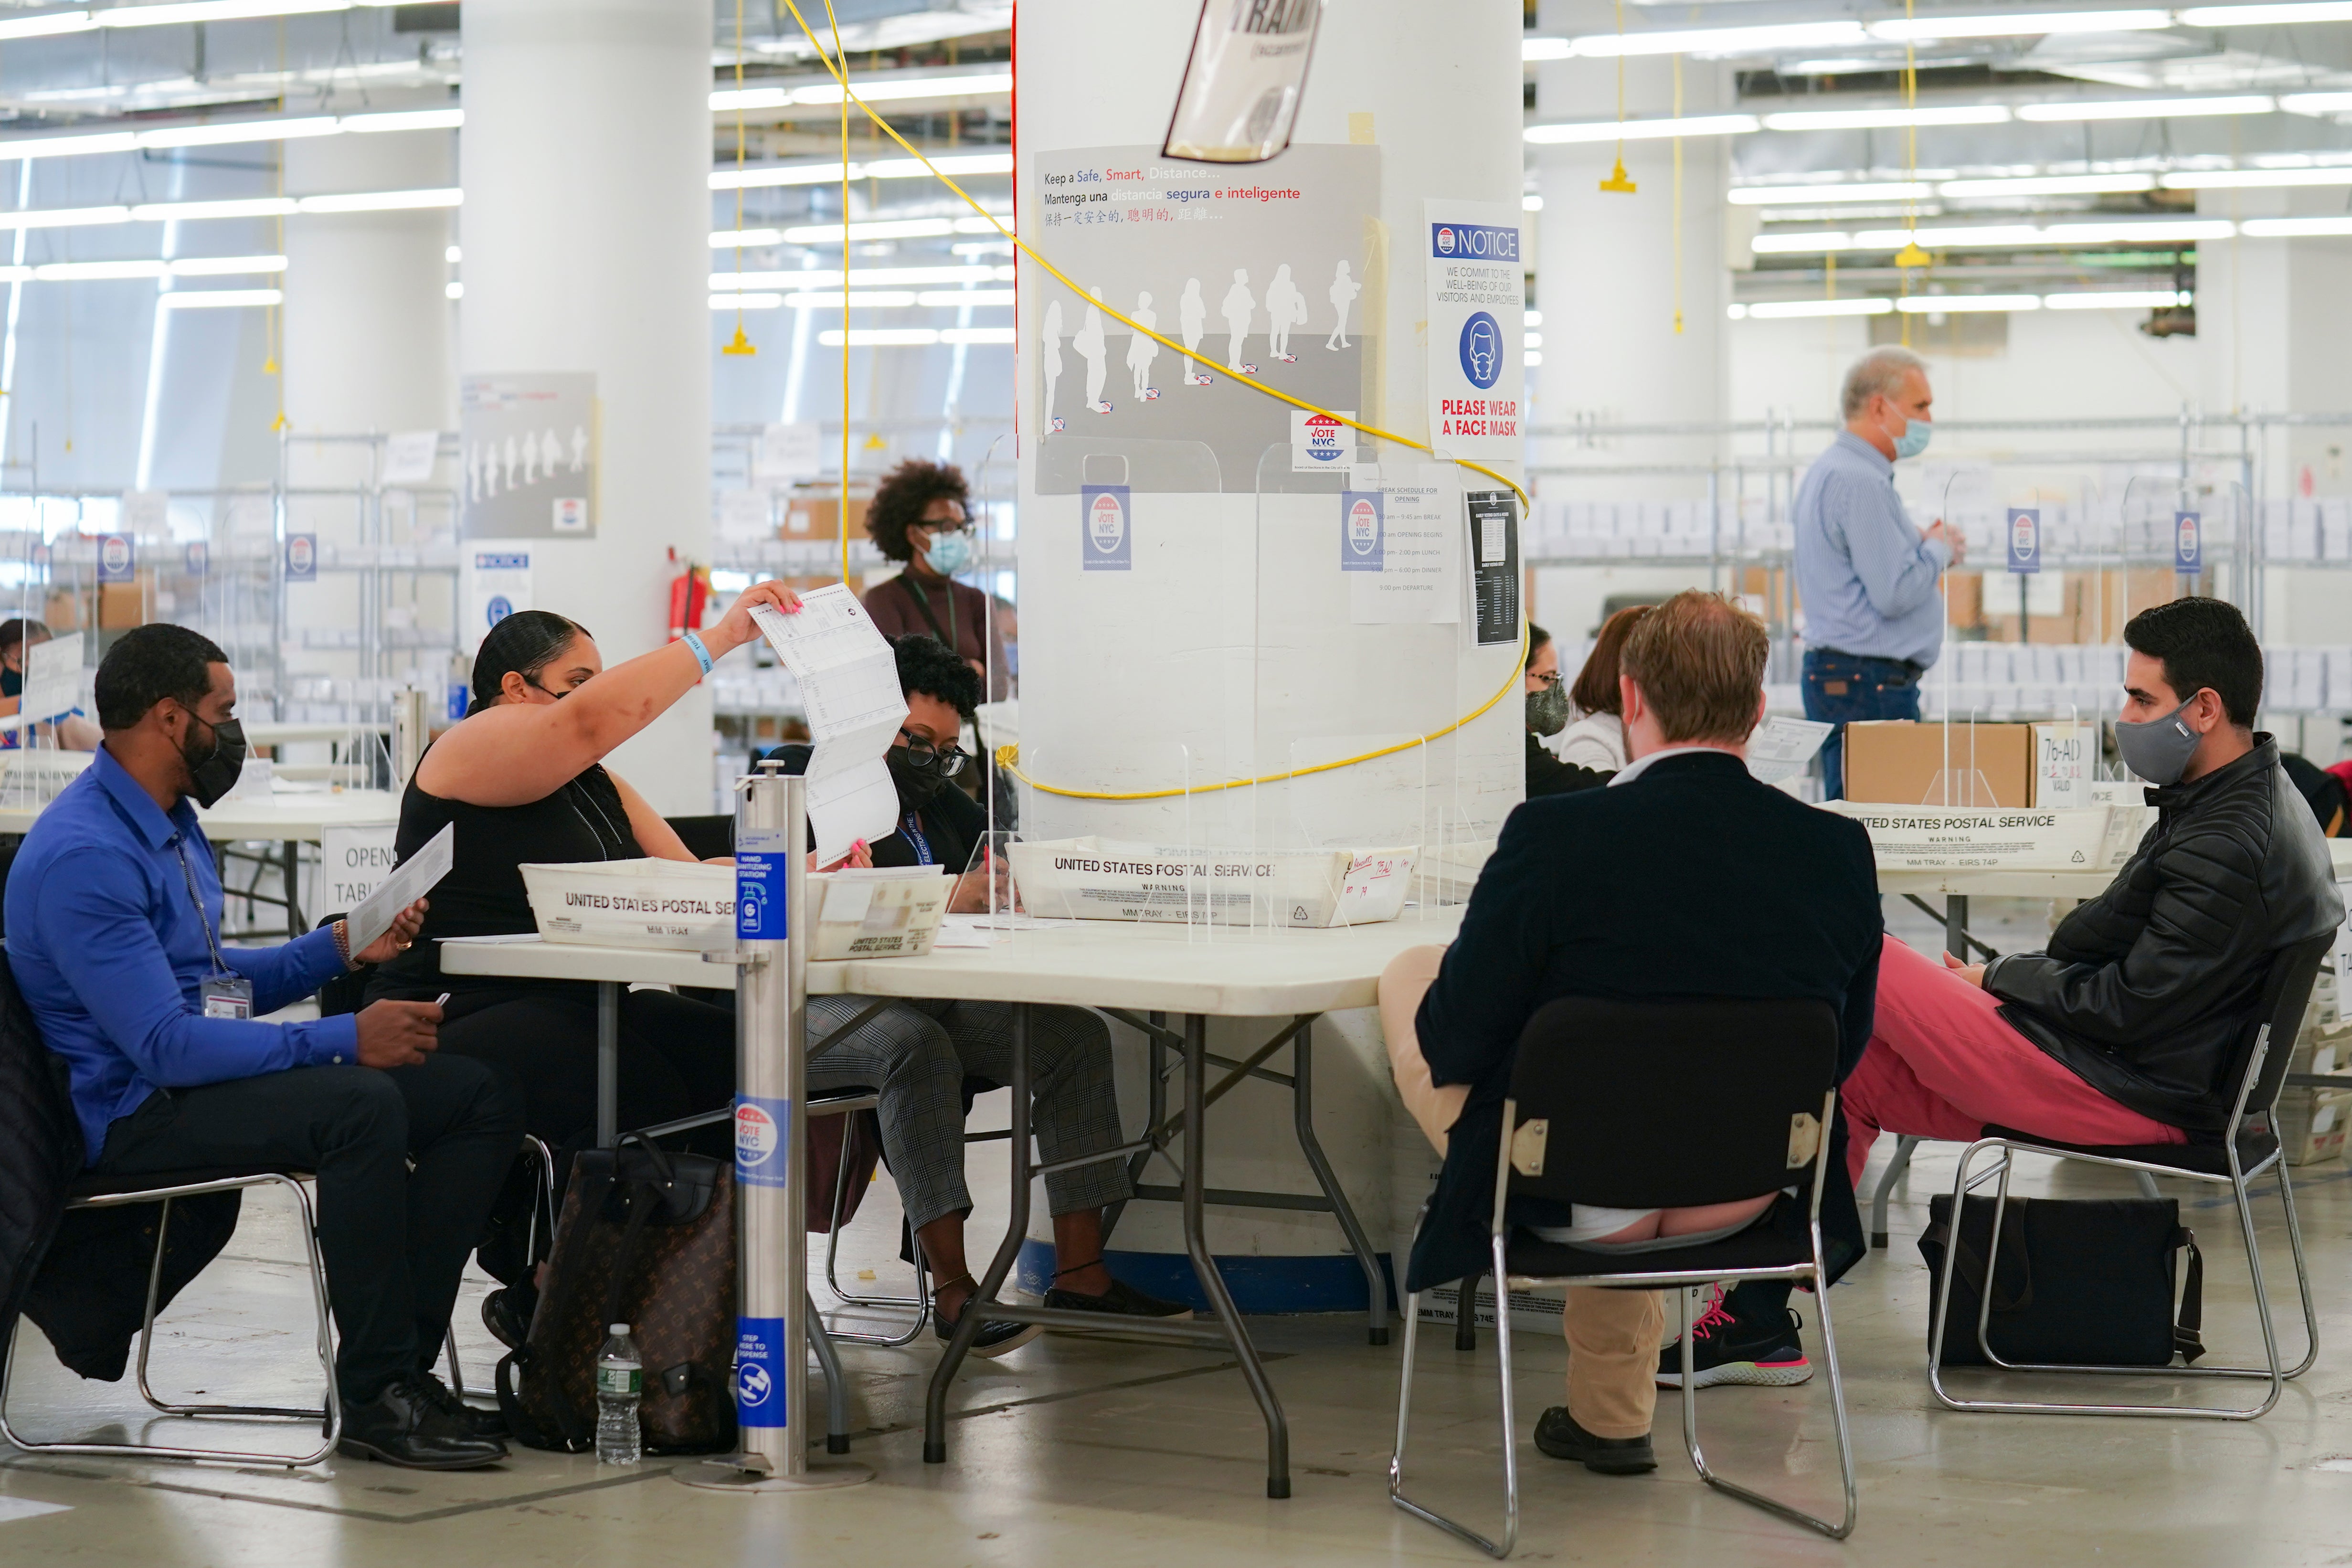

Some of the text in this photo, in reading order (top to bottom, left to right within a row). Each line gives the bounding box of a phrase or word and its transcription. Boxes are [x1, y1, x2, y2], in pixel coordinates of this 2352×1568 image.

[1045, 173, 1066, 187] Keep
[1077, 169, 1102, 182] Safe,
[1106, 169, 1144, 181] Smart,
[1150, 167, 1220, 179] Distance...
[1045, 194, 1086, 206] Mantenga
[1090, 193, 1108, 201] una
[1112, 188, 1162, 201] distancia
[1167, 190, 1210, 202] segura
[1228, 186, 1300, 202] inteligente
[1459, 230, 1515, 256] NOTICE
[1447, 267, 1510, 279] WE COMMIT TO THE
[1446, 280, 1511, 292] WELL-BEING OF OUR
[1437, 292, 1519, 305] VISITORS AND EMPLOYEES
[1442, 400, 1516, 416] PLEASE WEAR
[1311, 427, 1335, 437] VOTE
[1442, 420, 1516, 436] A FACE MASK
[1098, 511, 1114, 523] VOTE
[1356, 516, 1369, 527] VOTE
[1099, 524, 1114, 533] NYC
[1356, 528, 1369, 537] NYC
[1892, 818, 1940, 829] STATES
[1944, 817, 1995, 829] POSTAL
[1999, 816, 2055, 827] SERVICE
[914, 833, 930, 862] ELECTIONS
[1055, 858, 1100, 872] UNITED
[1103, 861, 1153, 875] STATES
[1156, 864, 1211, 877] POSTAL
[1142, 883, 1185, 891] WARNING
[566, 892, 609, 908] UNITED
[613, 896, 658, 912] STATES
[662, 900, 711, 914] POSTAL
[667, 926, 688, 935] TRAY
[853, 937, 878, 945] UNITED
[740, 1122, 760, 1136] VOTE
[740, 1136, 760, 1146] NYC
[1434, 1310, 1453, 1319] TRAY
[1480, 1314, 1494, 1323] 74E
